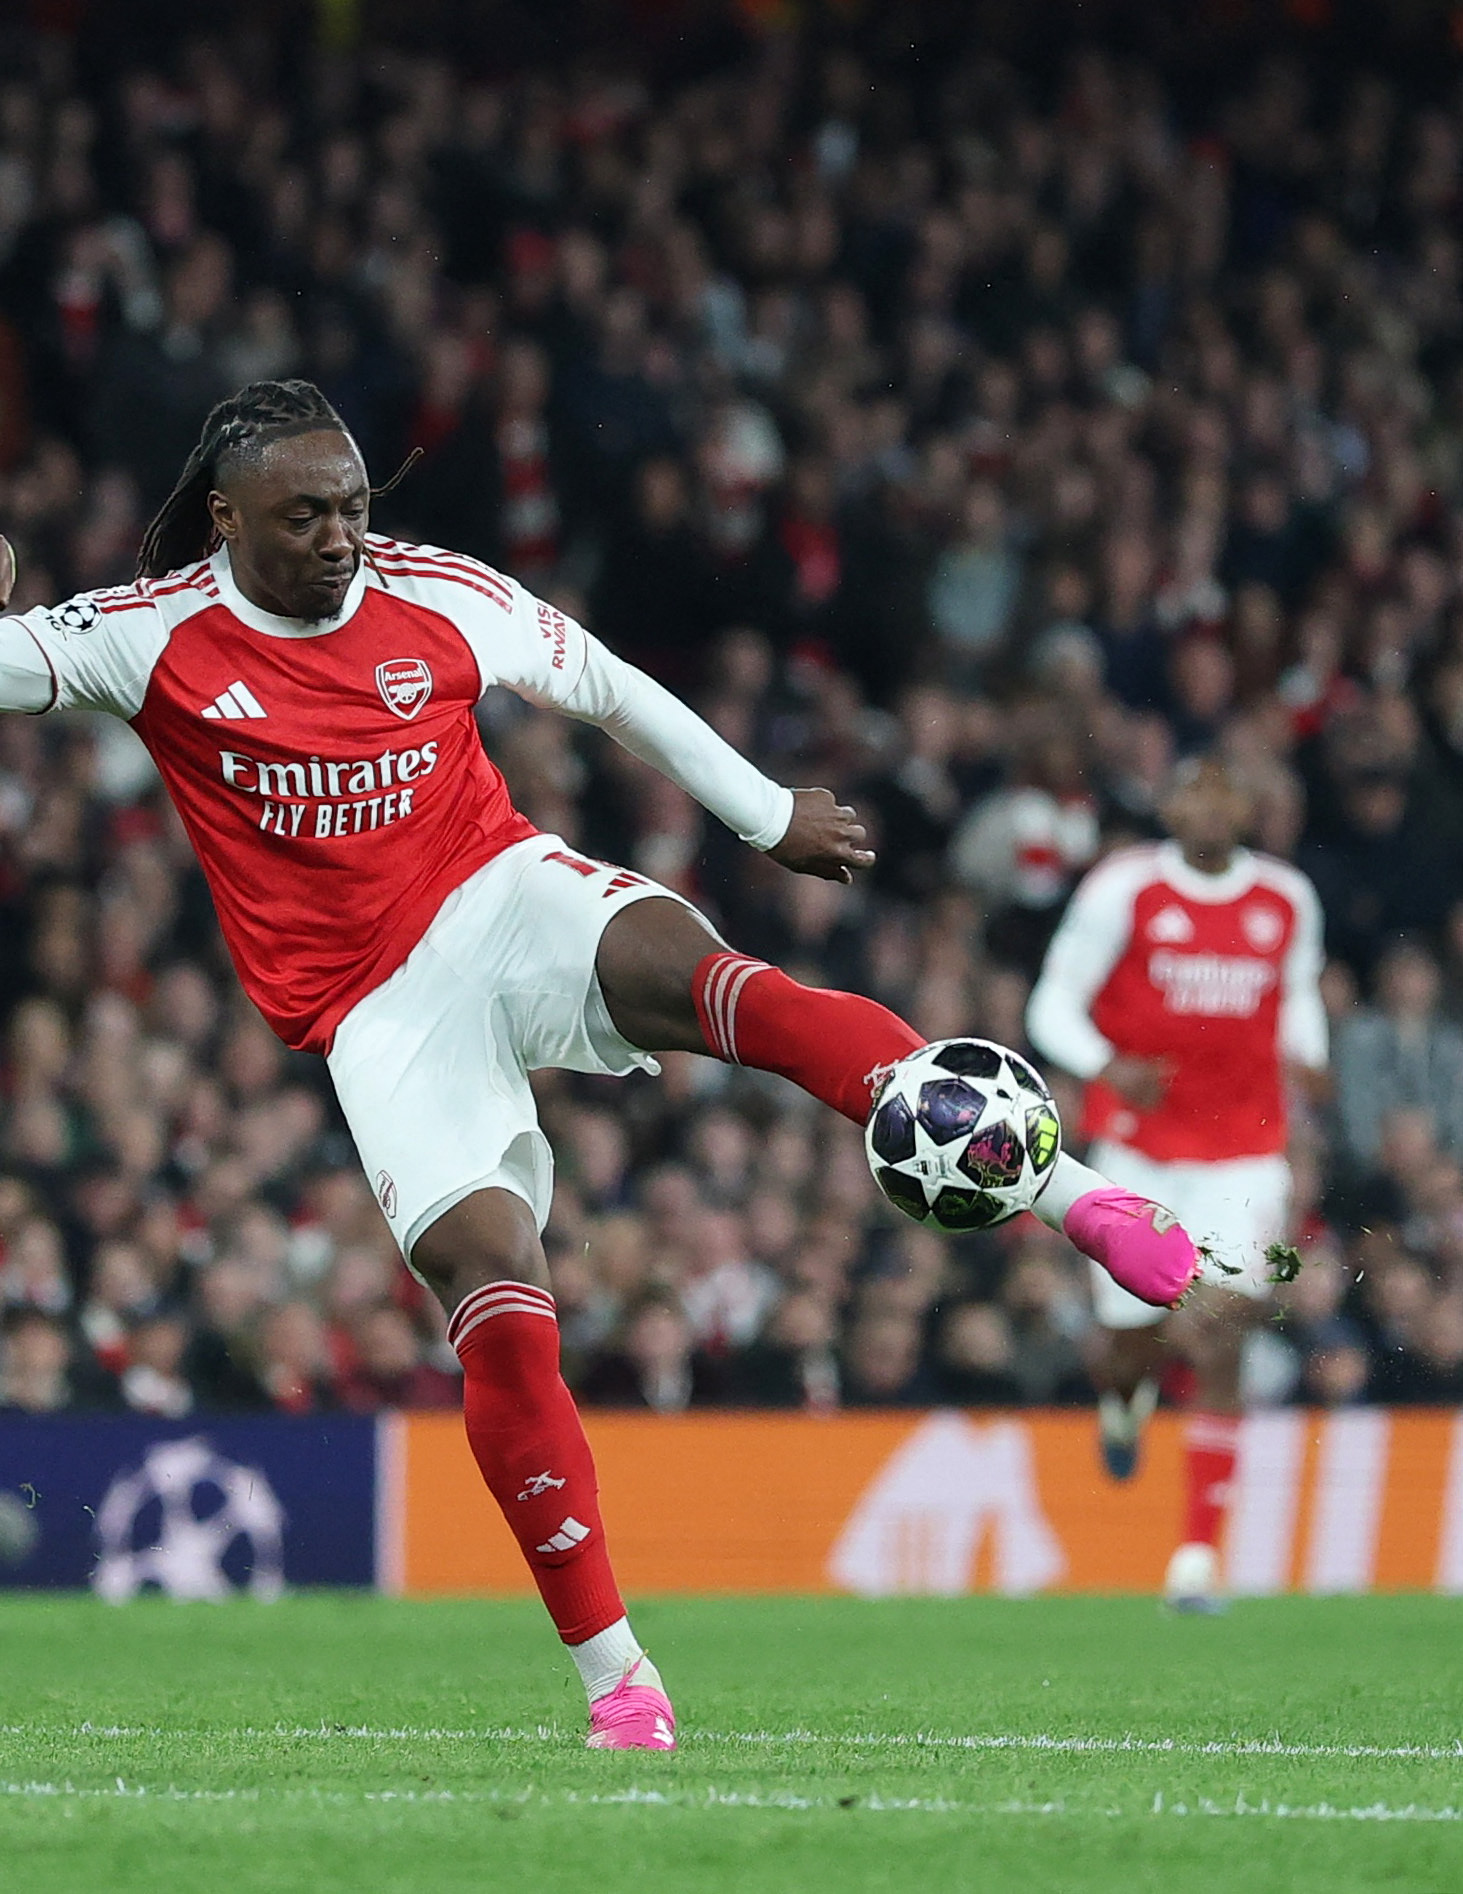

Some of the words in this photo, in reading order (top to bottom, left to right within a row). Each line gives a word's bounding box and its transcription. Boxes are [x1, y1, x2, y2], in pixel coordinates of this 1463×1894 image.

[384, 667, 425, 682] Arsenal
[218, 740, 439, 798] Emirates
[259, 801, 306, 838] FLY
[315, 788, 415, 839] BETTER
